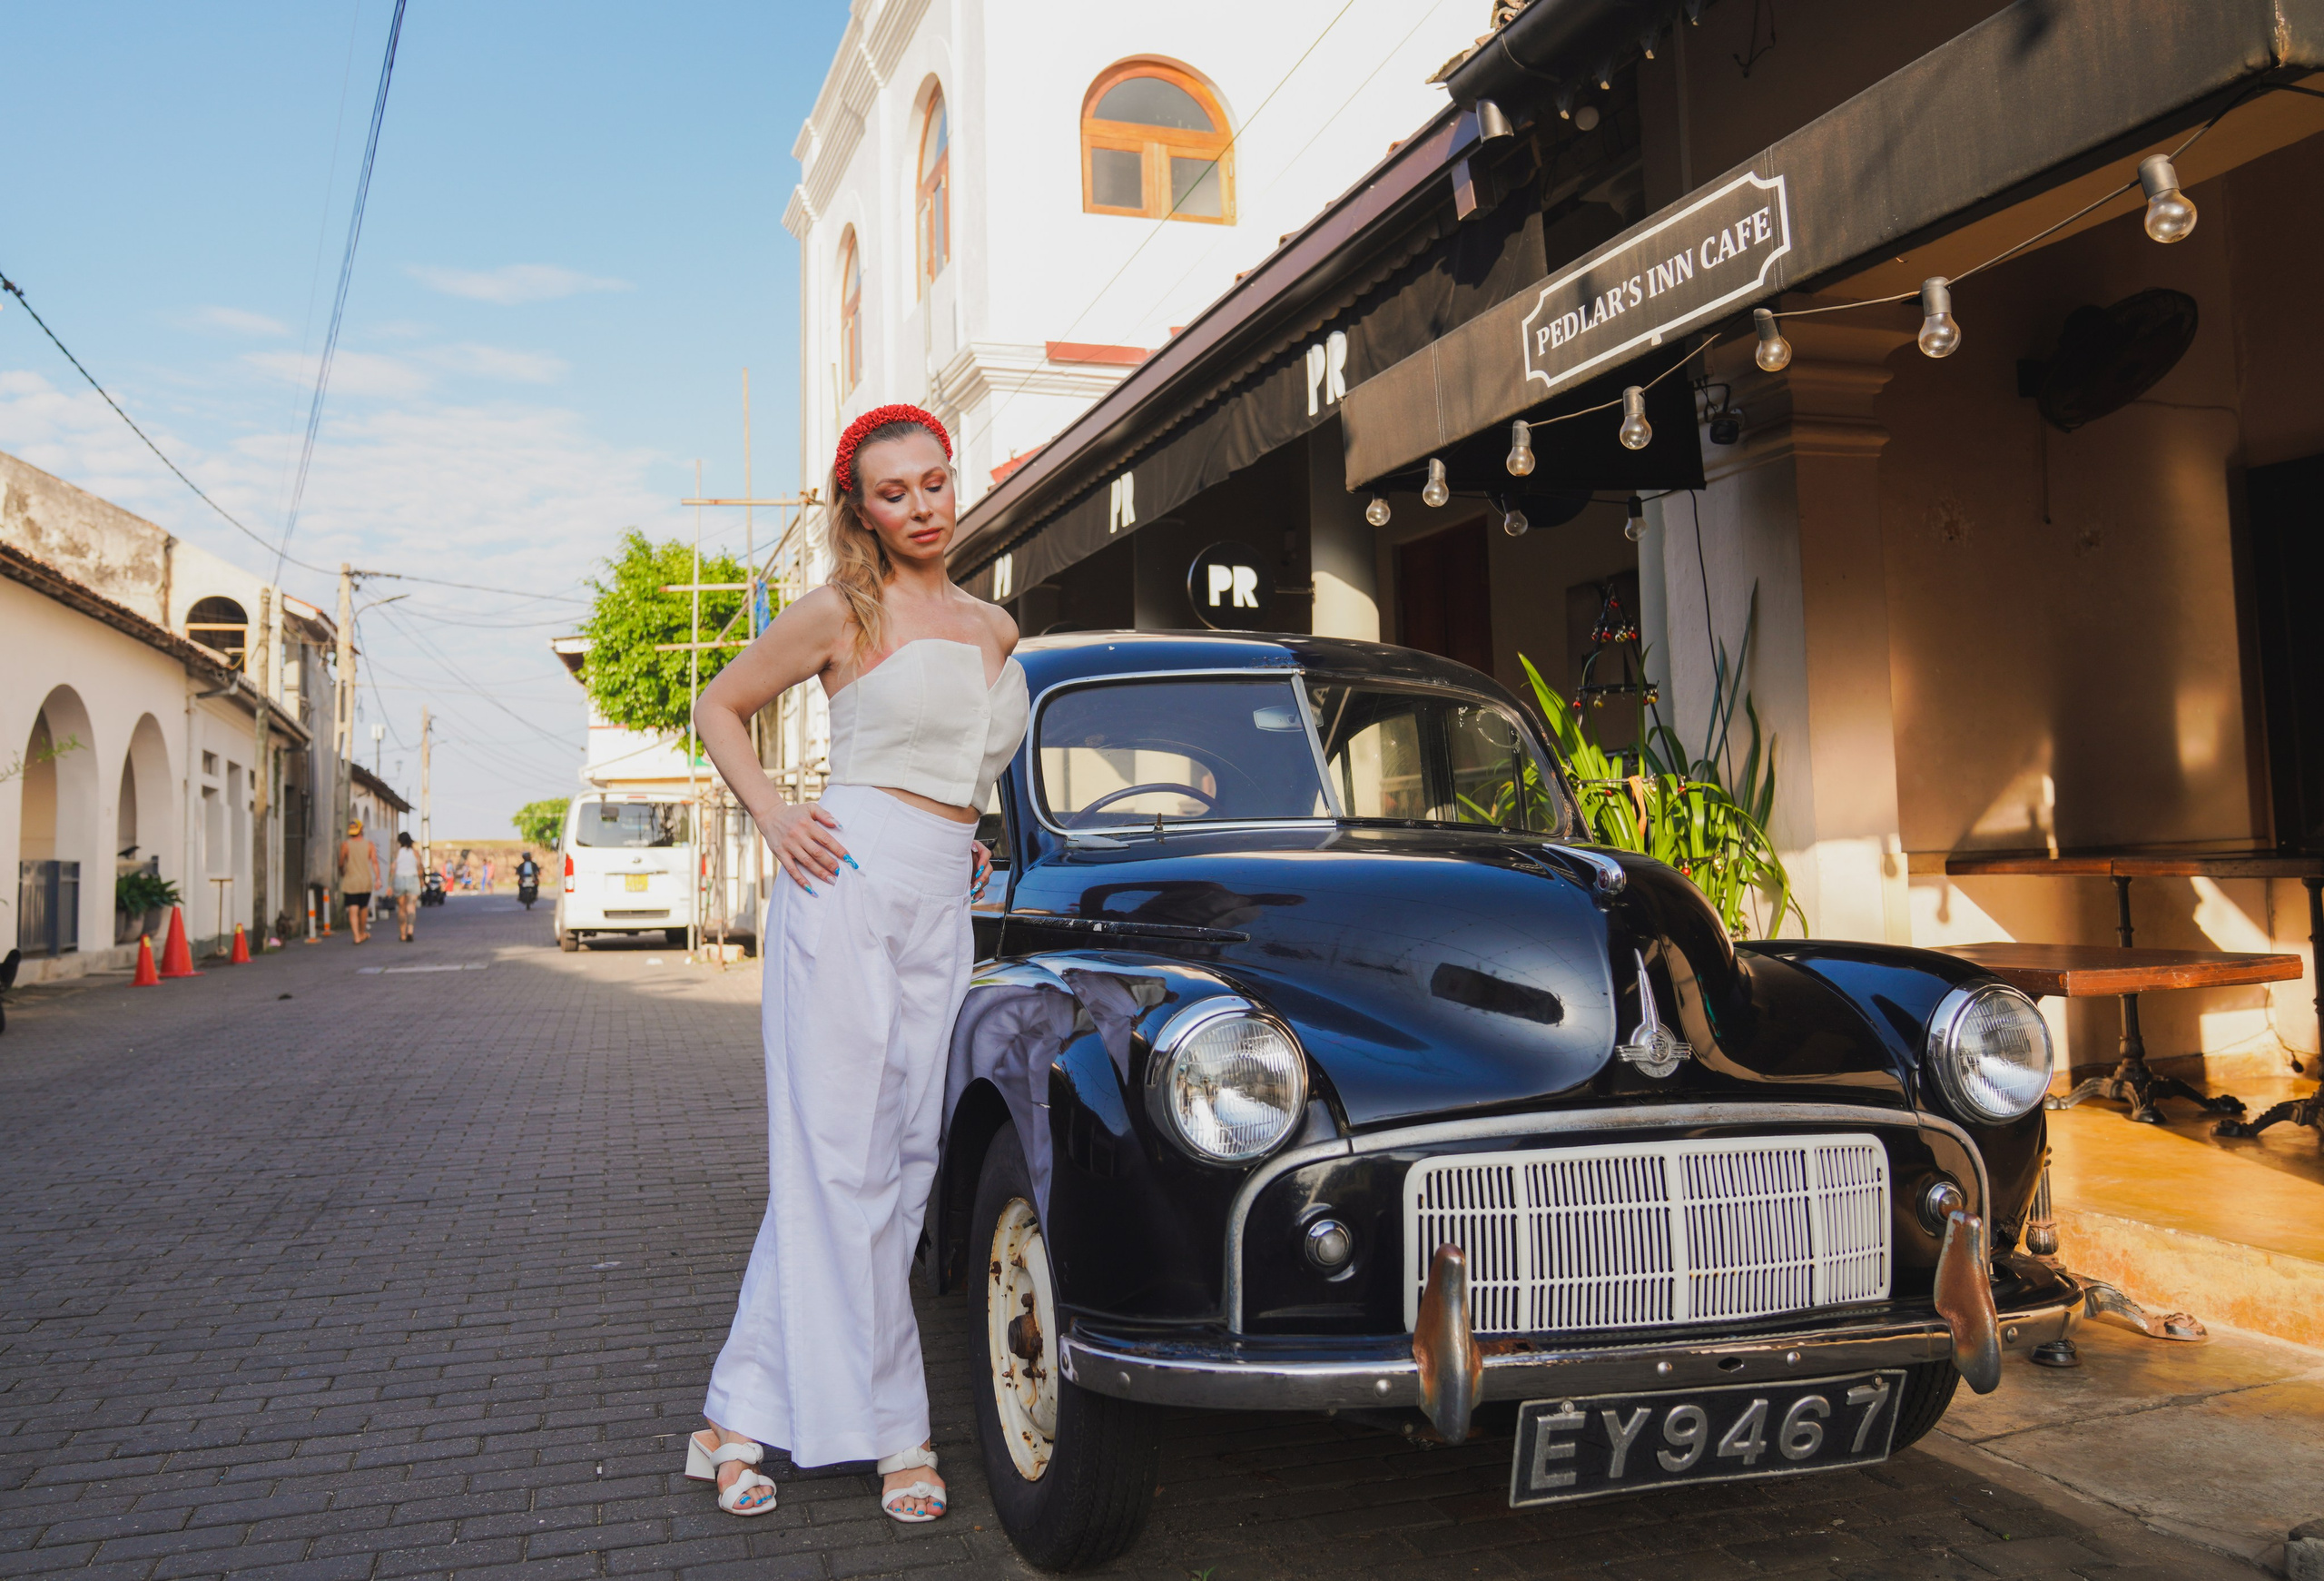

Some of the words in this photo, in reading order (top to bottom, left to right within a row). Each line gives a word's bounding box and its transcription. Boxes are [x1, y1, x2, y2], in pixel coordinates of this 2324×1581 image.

[1536, 274, 1642, 357] PEDLAR'S
[1646, 248, 1694, 299] INN
[1699, 206, 1771, 270] CAFE
[1306, 331, 1347, 417] PR
[1109, 470, 1137, 534] PR
[1207, 564, 1259, 608] PR
